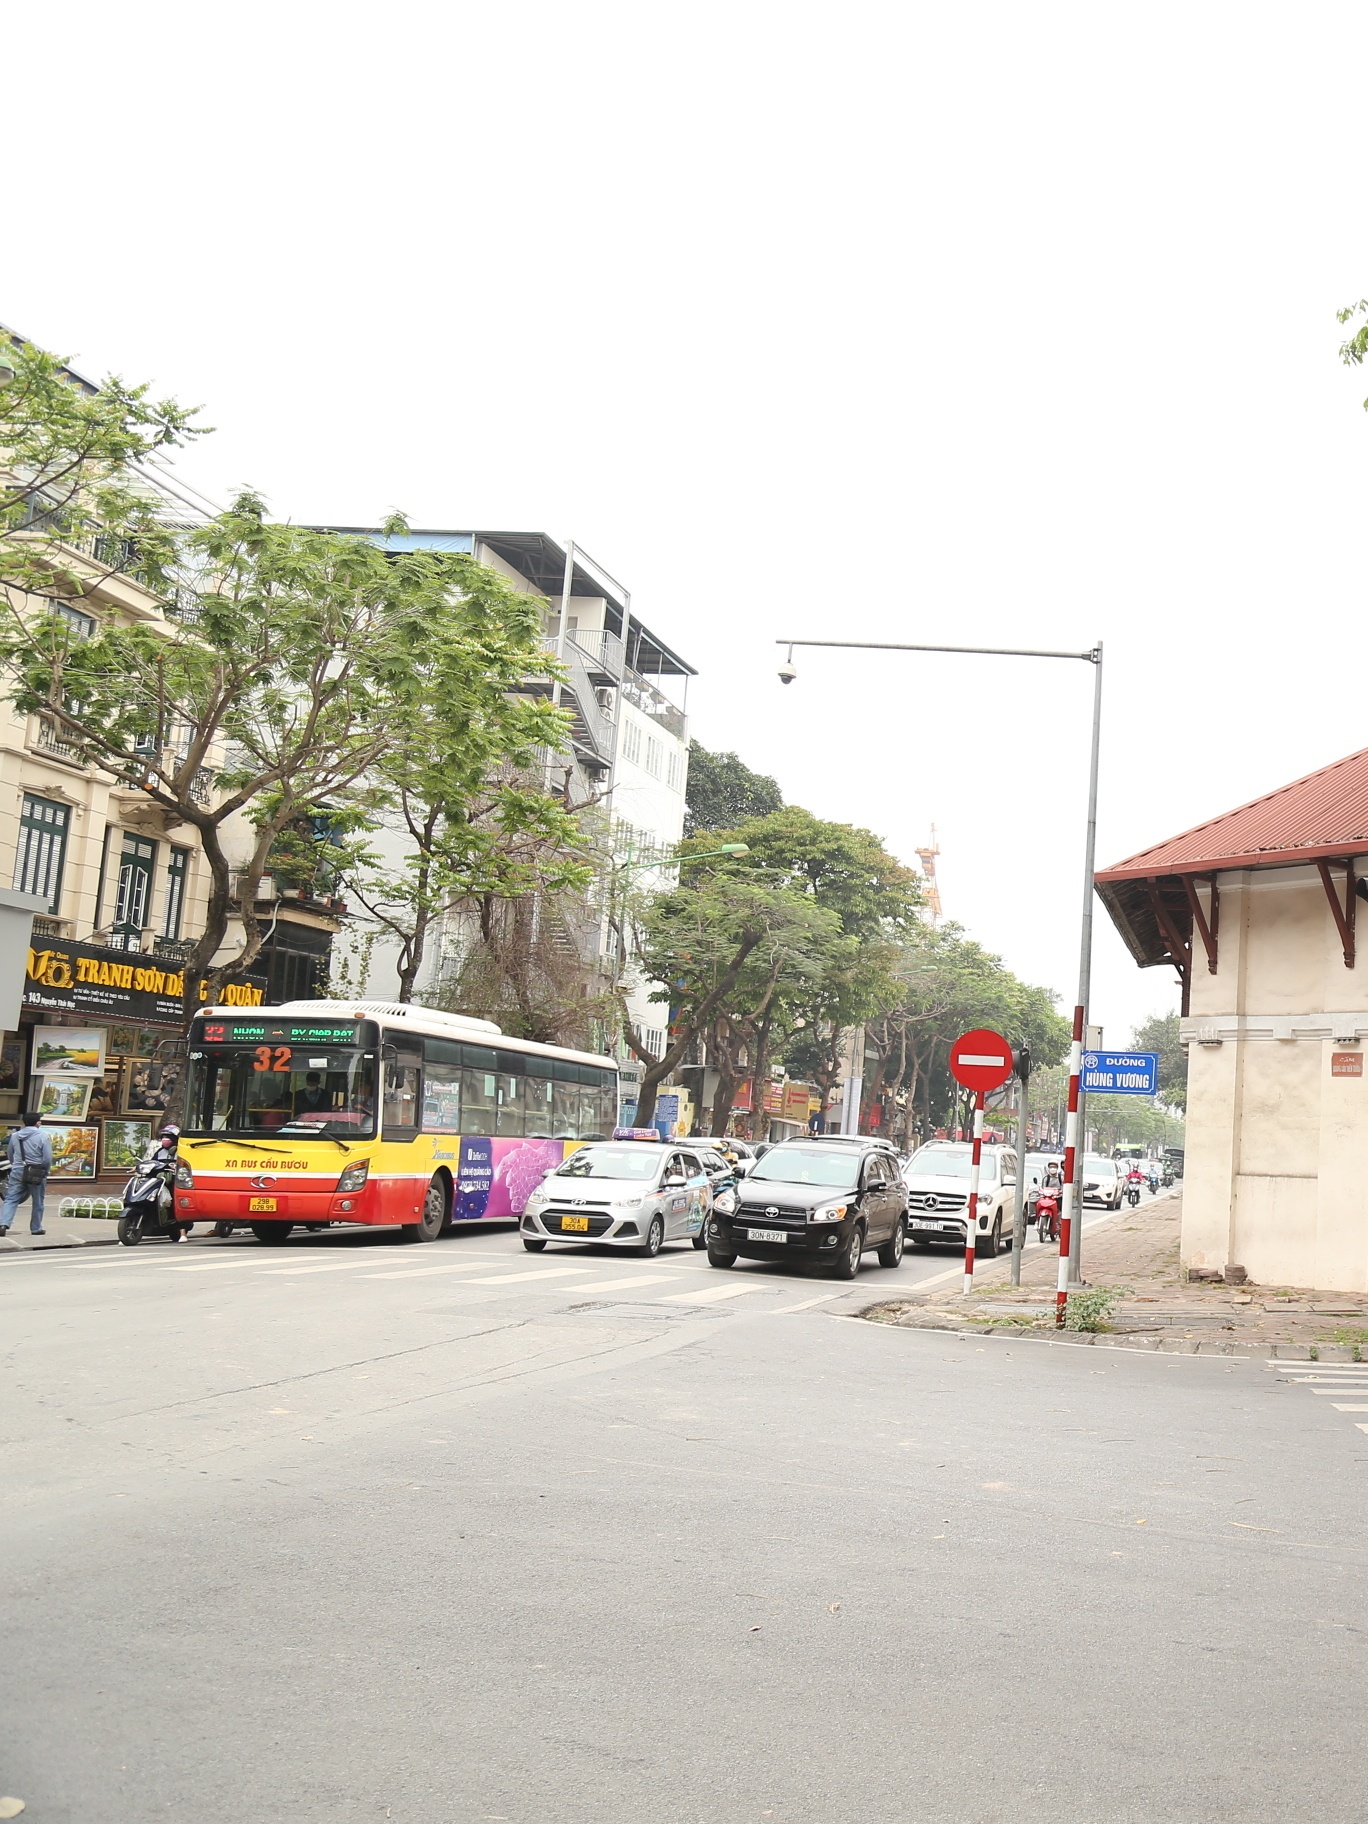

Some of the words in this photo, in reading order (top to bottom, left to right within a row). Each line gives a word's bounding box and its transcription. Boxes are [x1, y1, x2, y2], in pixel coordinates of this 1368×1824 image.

[76, 957, 133, 989] TRANH
[134, 966, 166, 994] SƠN
[225, 982, 263, 1007] QUÂN
[28, 992, 41, 1003] 143
[253, 1046, 292, 1072] 32
[1105, 1056, 1146, 1067] ĐƯỜNG
[1086, 1069, 1113, 1087] HÙNG
[1116, 1072, 1150, 1088] VƯƠNG
[240, 1160, 258, 1169] BUS
[750, 1231, 783, 1241] 30N-8371
